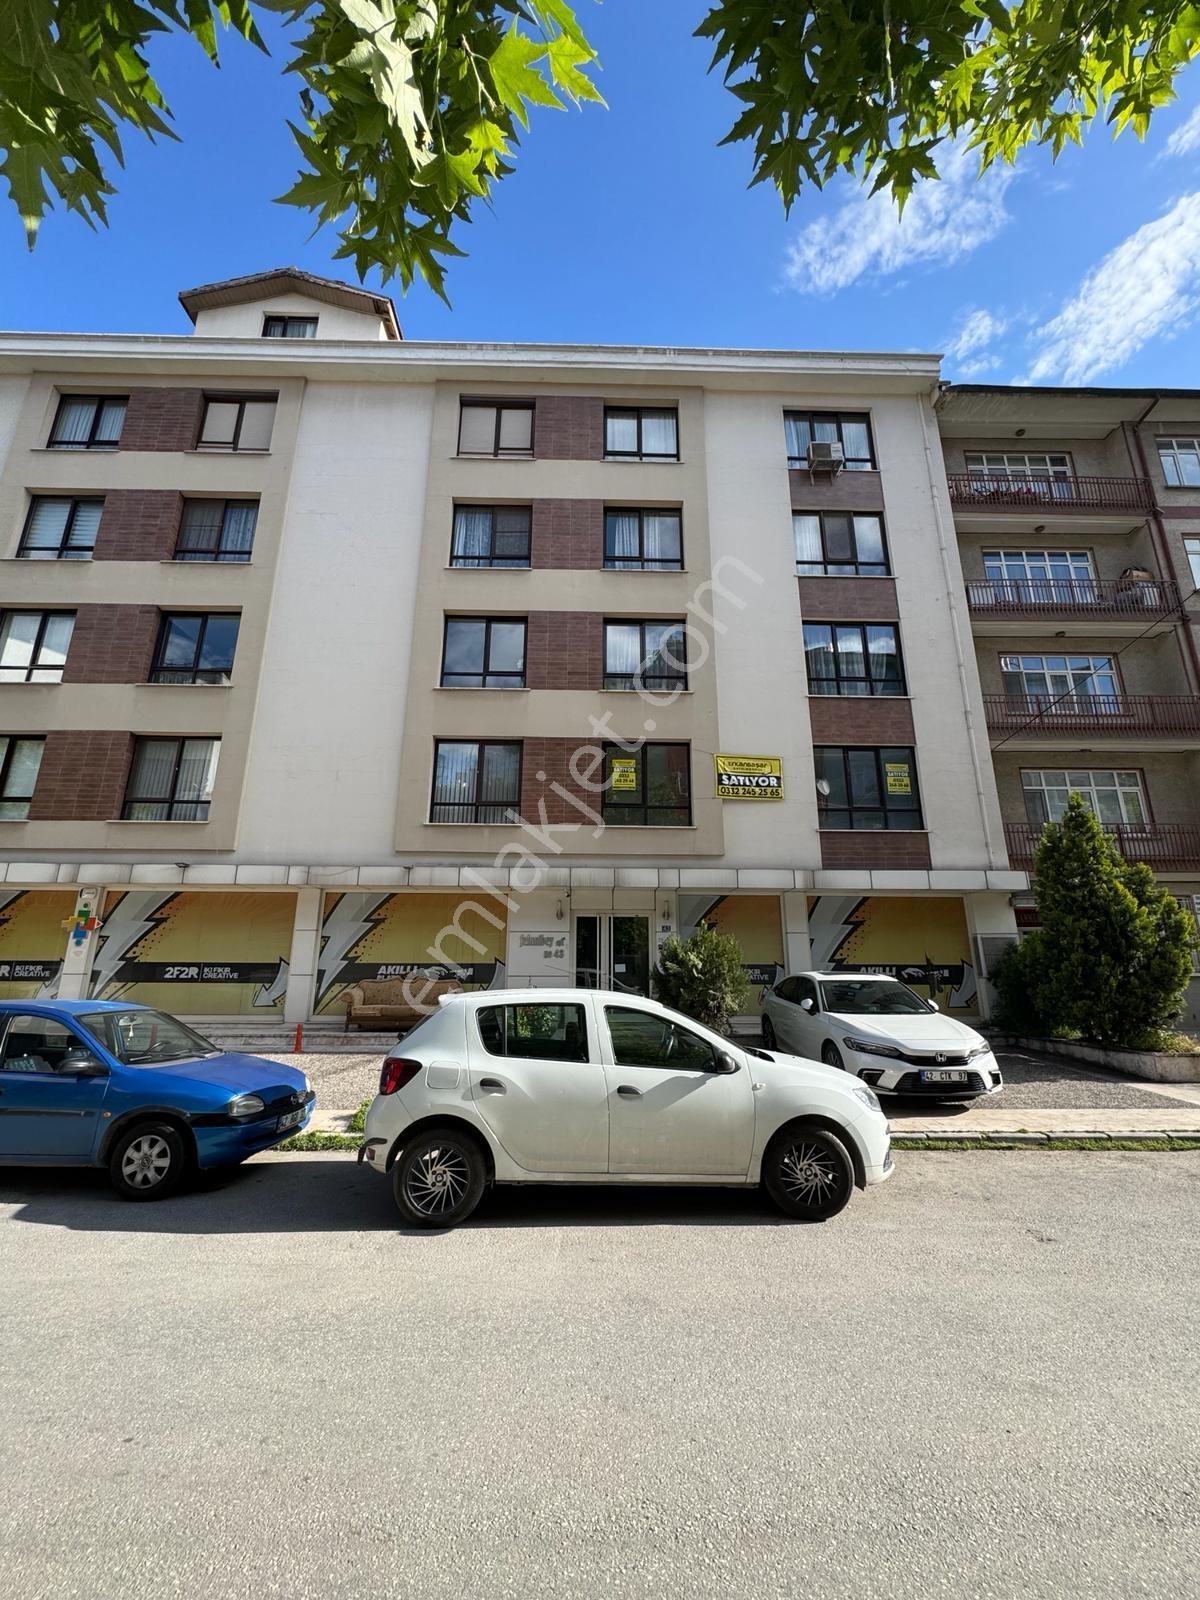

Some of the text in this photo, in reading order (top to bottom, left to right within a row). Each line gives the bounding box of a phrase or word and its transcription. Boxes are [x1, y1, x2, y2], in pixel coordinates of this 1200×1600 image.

[721, 774, 778, 787] SATIYOR
[720, 786, 740, 795] 0332
[742, 787, 757, 796] 245
[769, 788, 780, 797] 65
[164, 966, 199, 979] 2F2R
[925, 1071, 934, 1081] 42
[958, 1071, 967, 1081] 97
